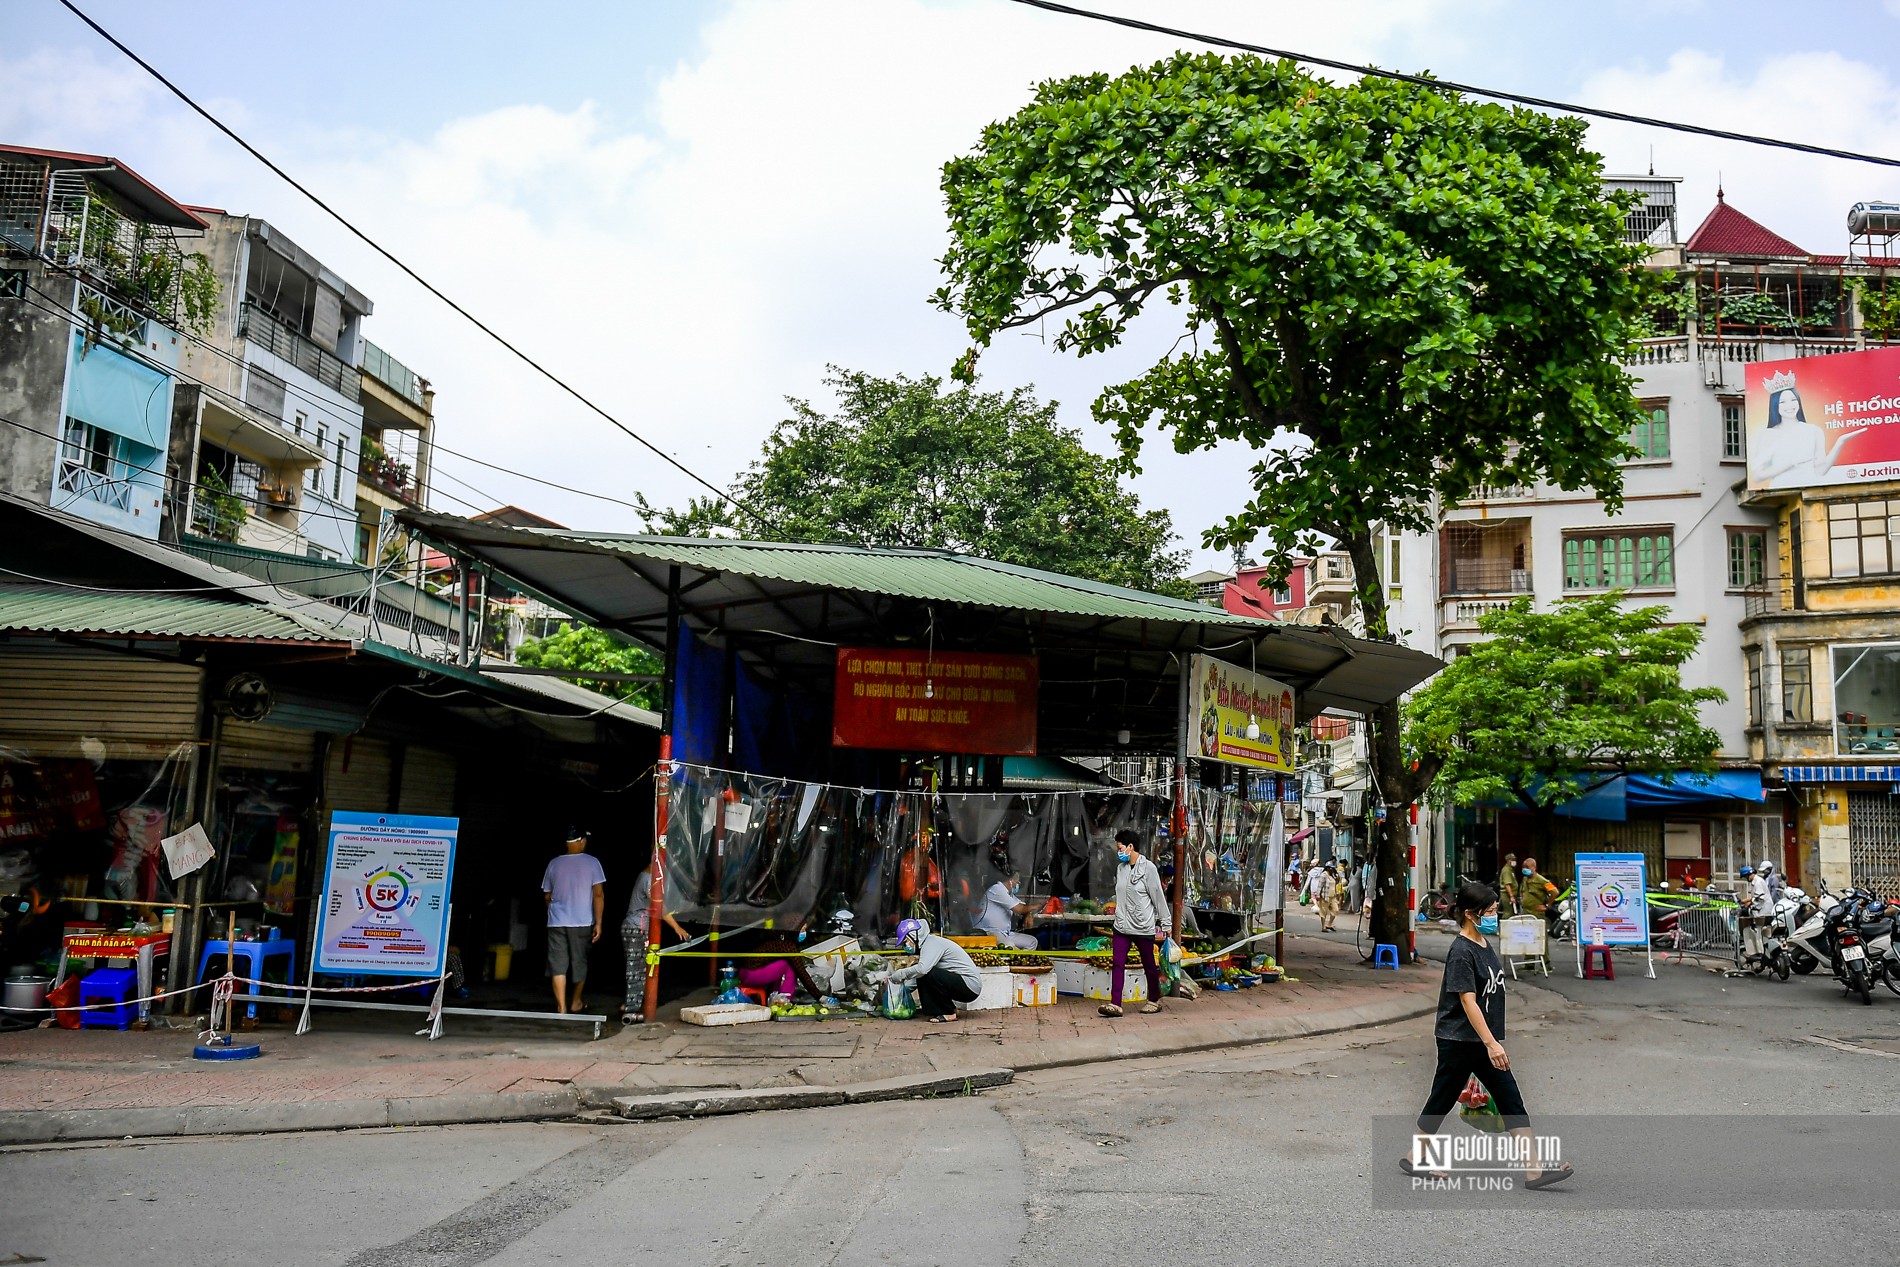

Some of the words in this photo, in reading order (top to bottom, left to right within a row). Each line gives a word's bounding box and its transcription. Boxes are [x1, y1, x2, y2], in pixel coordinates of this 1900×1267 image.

[1824, 400, 1843, 416] HỆ
[1825, 419, 1844, 429] TIÊN
[1846, 417, 1883, 428] PHONG
[1884, 413, 1900, 424] ĐÀ
[847, 659, 862, 676] LỰA
[864, 660, 885, 677] CHỌN
[895, 682, 910, 699] GỐC
[895, 707, 907, 721] AN
[909, 705, 929, 722] TOÀN
[931, 706, 946, 723] SỨC
[360, 825, 379, 833] ĐƯỜNG
[376, 888, 399, 902] 5K
